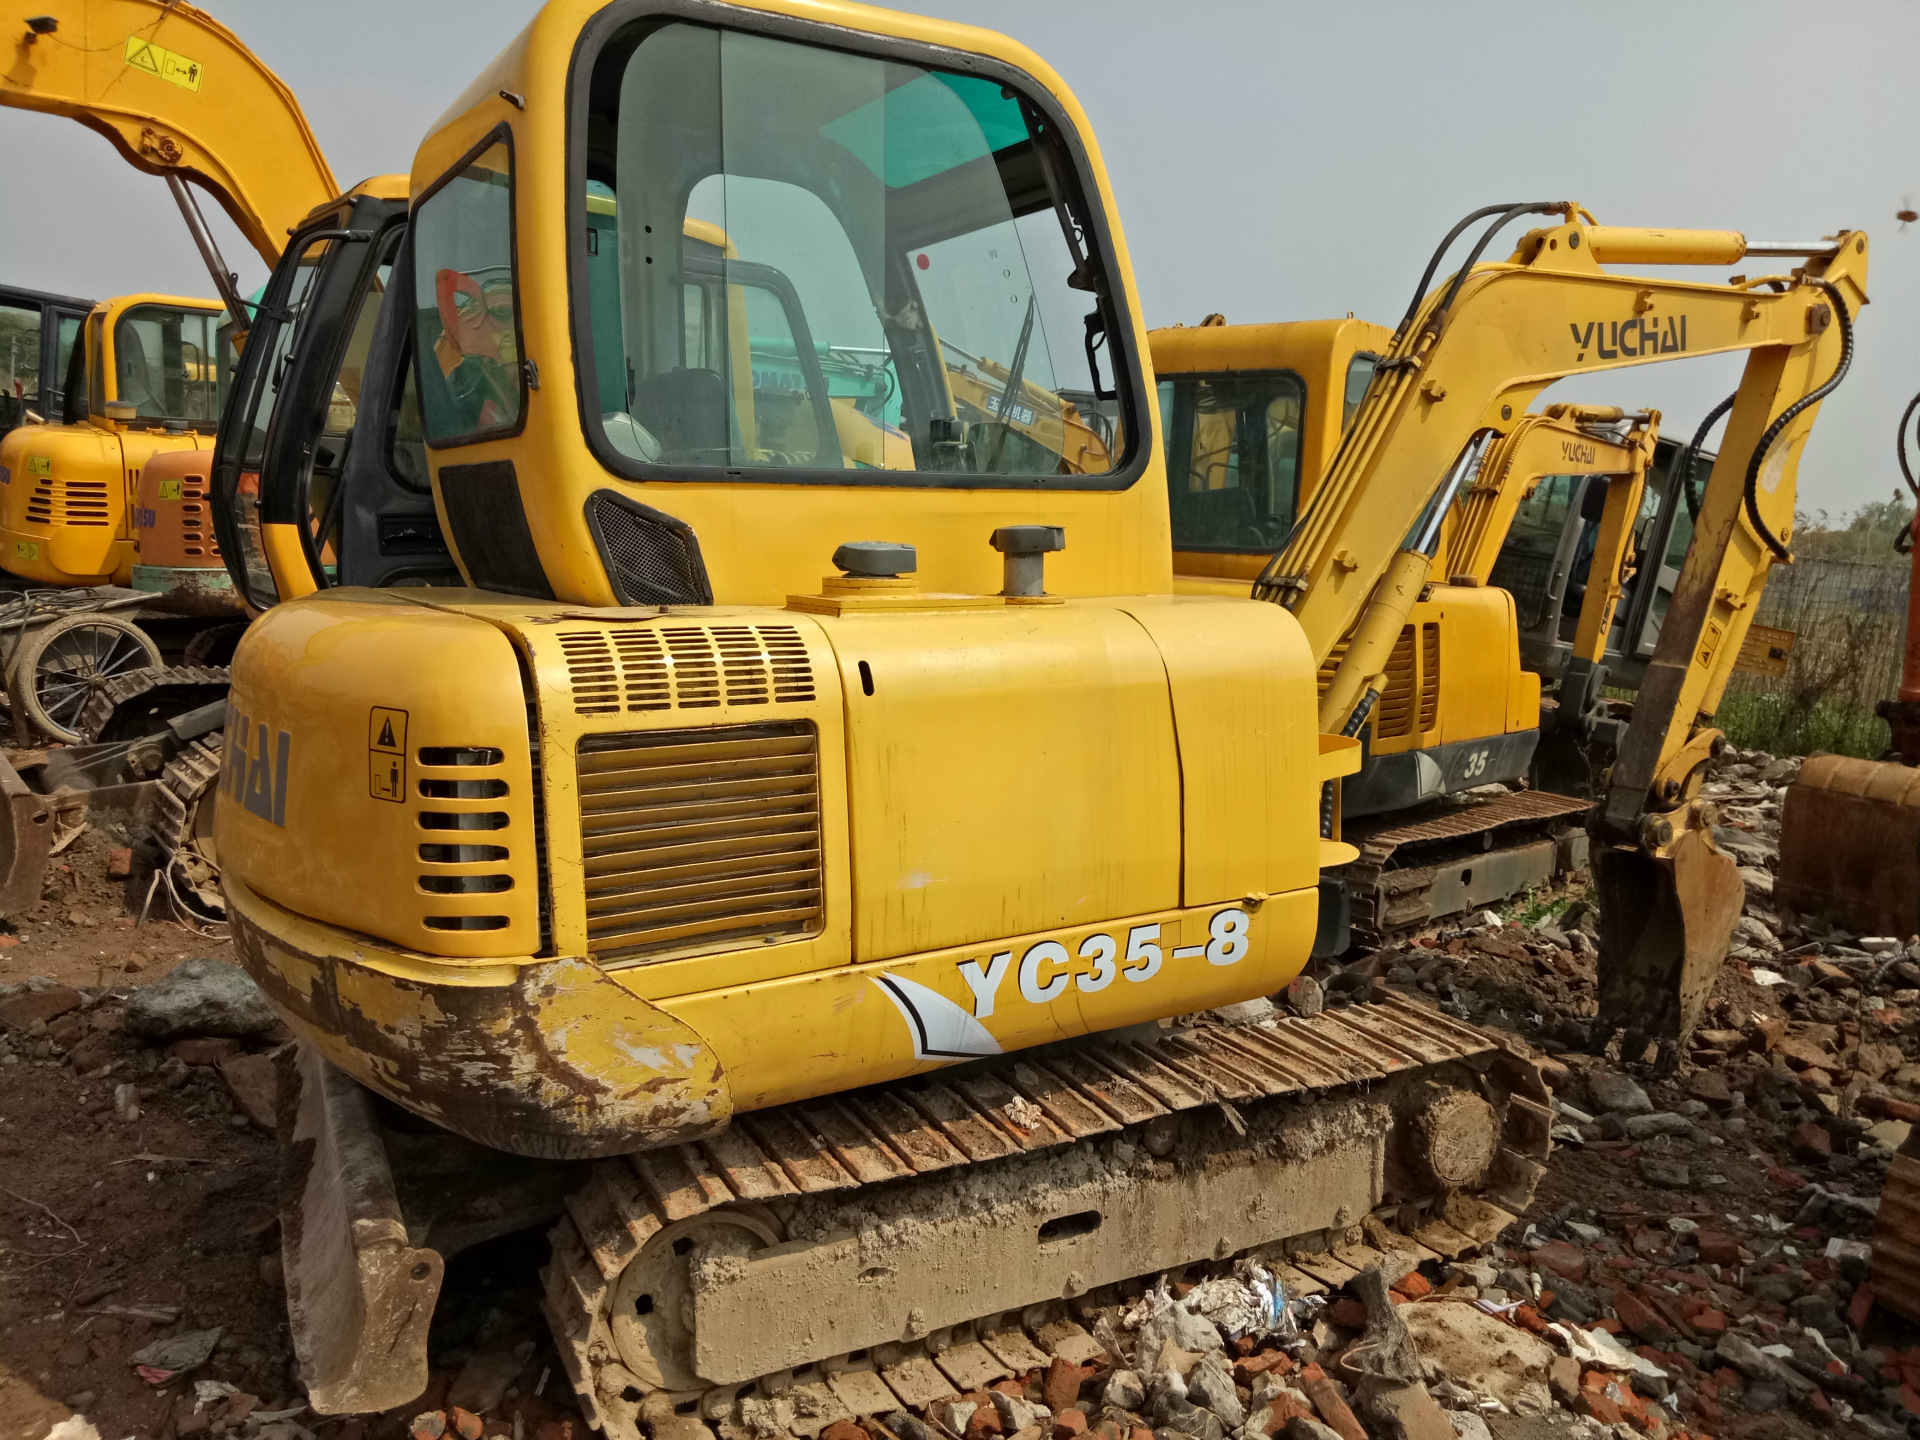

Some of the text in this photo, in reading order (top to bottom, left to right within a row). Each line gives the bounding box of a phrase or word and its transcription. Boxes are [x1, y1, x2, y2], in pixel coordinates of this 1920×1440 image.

[1570, 315, 1686, 362] YUCHAI
[1562, 441, 1595, 464] YUCHAI
[956, 907, 1250, 1018] YC35-8
